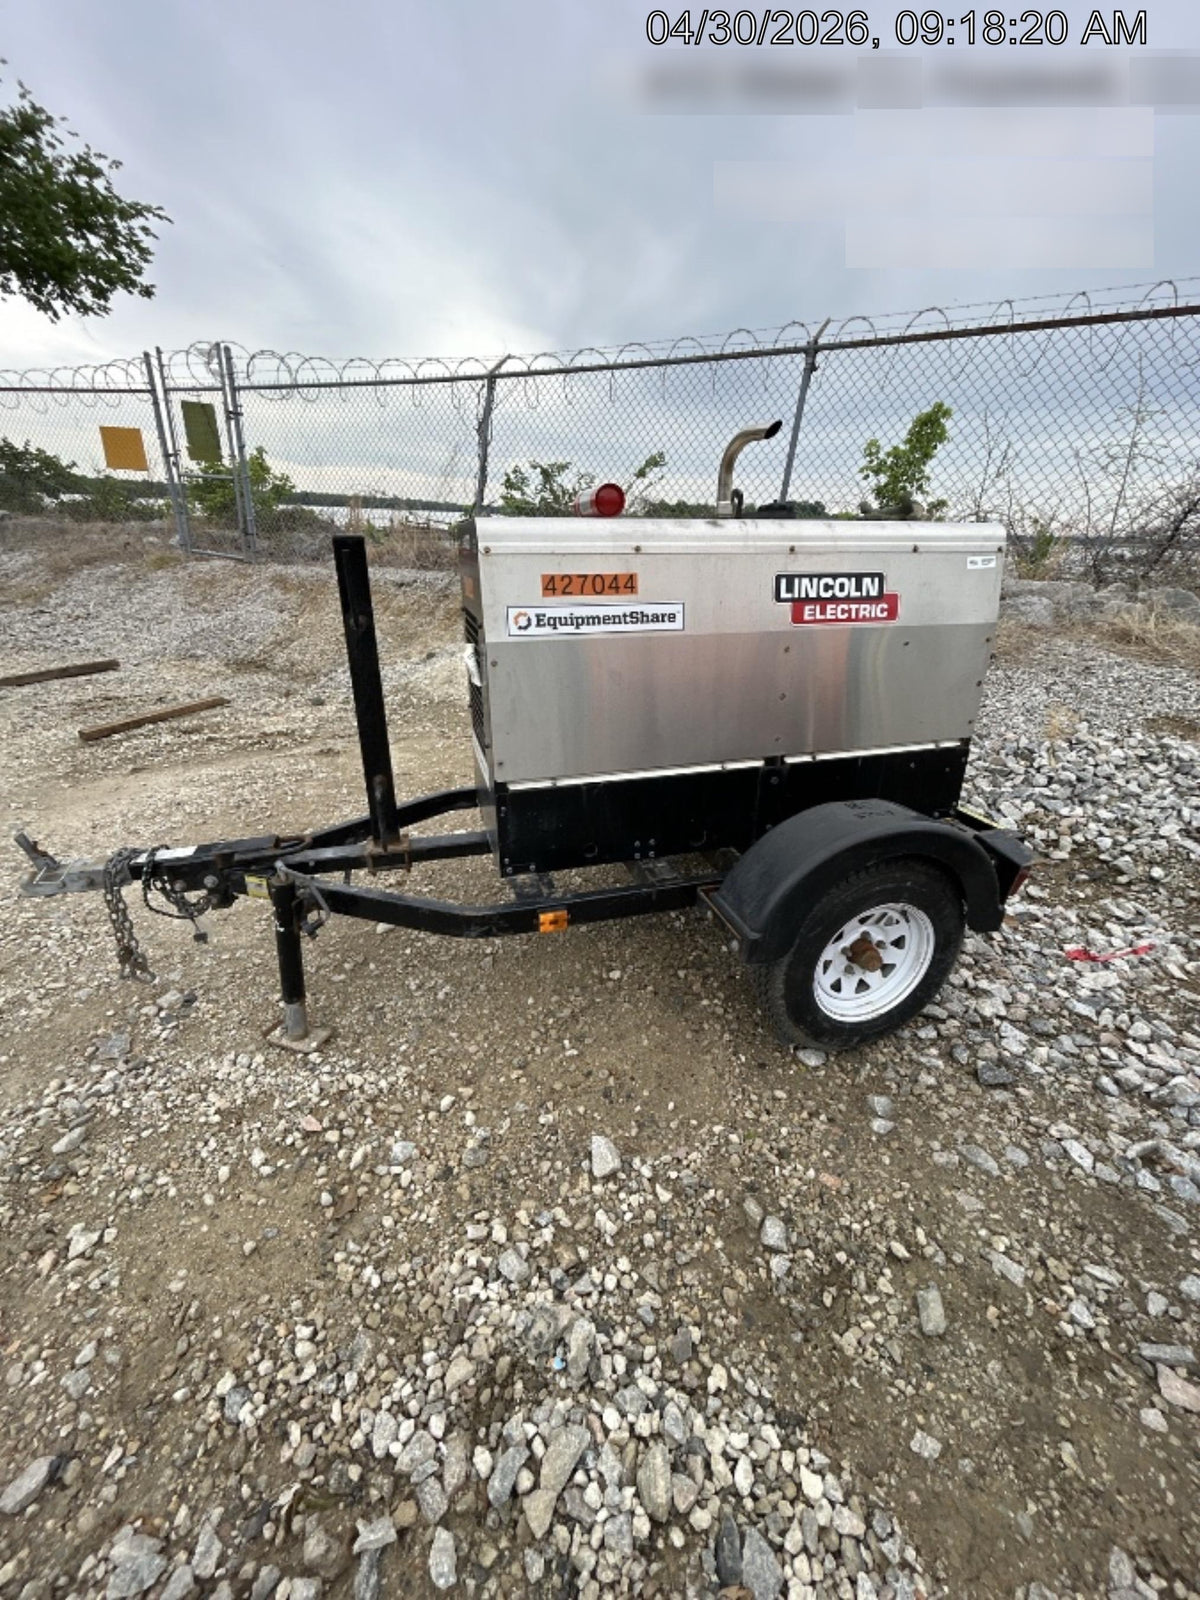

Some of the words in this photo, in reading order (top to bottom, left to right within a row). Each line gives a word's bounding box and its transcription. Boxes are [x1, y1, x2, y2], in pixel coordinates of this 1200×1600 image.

[543, 574, 636, 595] 427044
[780, 577, 880, 599] LINCOLN
[534, 611, 677, 630] EquipmentShare
[803, 603, 889, 620] ELECTRIC
